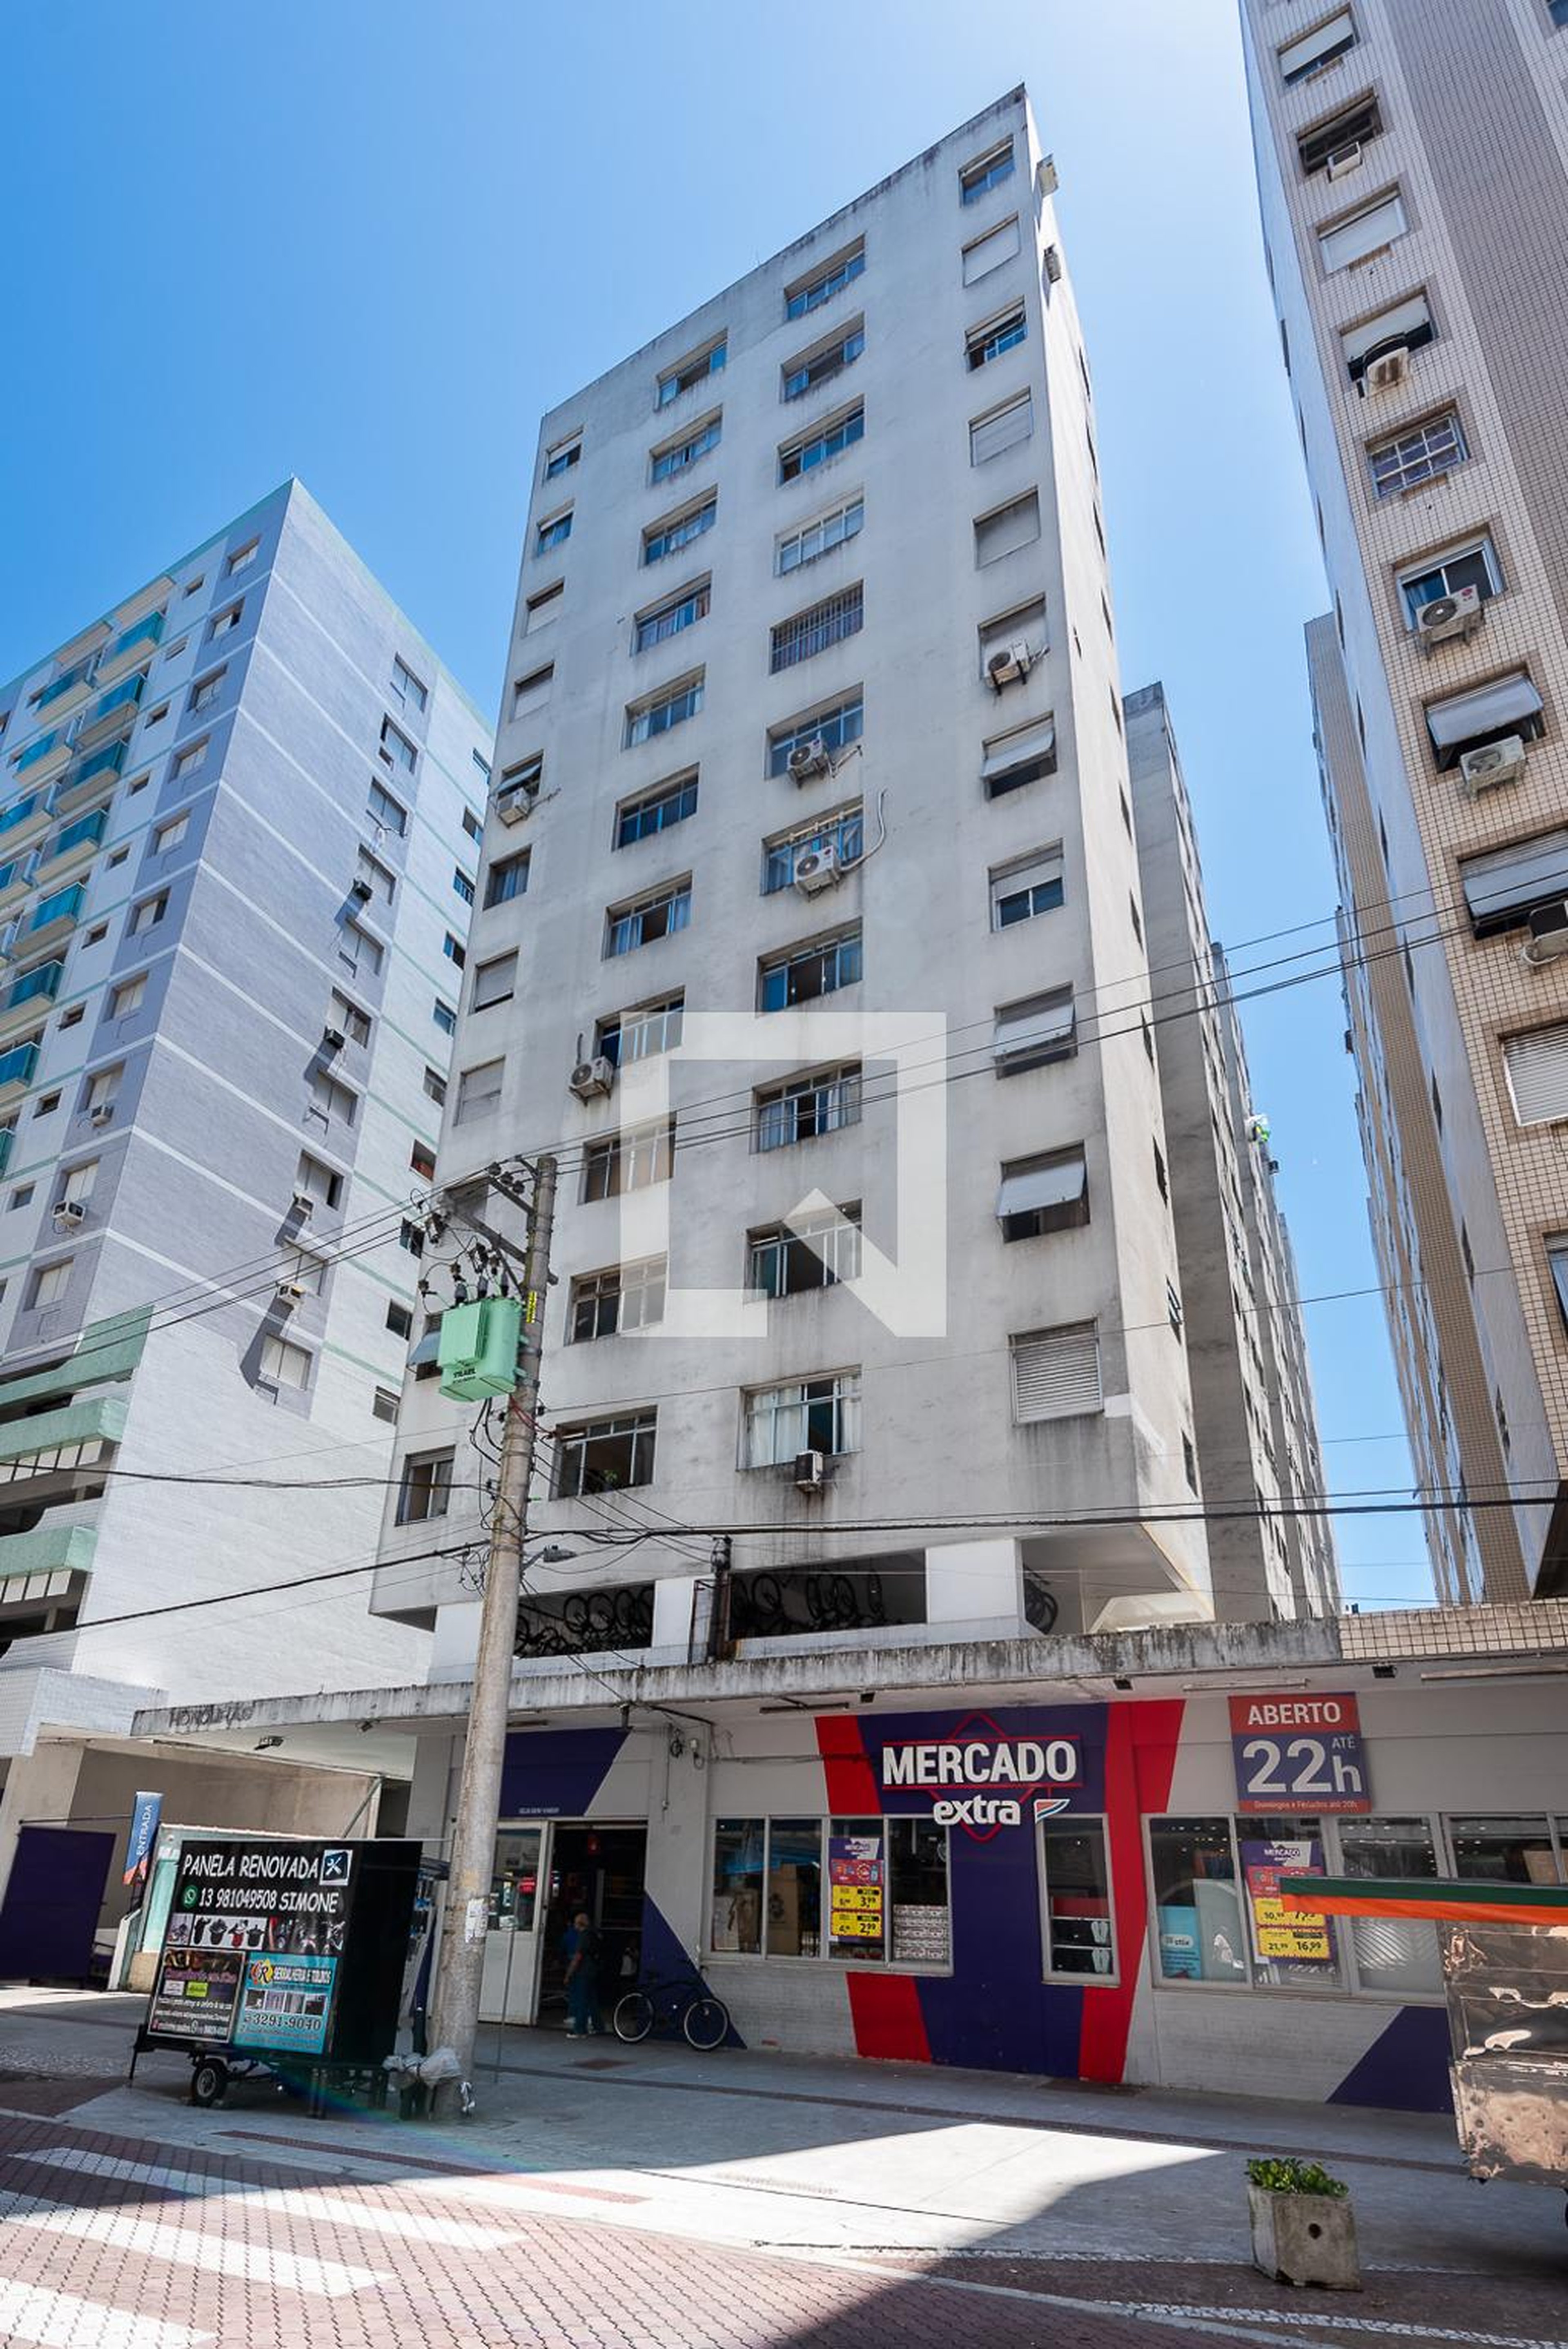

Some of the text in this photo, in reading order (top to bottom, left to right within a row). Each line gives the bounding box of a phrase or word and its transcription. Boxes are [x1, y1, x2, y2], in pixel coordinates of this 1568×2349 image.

[1248, 1702, 1342, 1725] ABERTO
[1332, 1734, 1356, 1749] ATÉ
[882, 1740, 1077, 1785] MERCADO
[1243, 1738, 1363, 1792] 22h
[933, 1795, 1021, 1825] extra
[136, 1805, 153, 1856] ENTRADA
[182, 1854, 319, 1879] PANELA RENOVADA
[199, 1888, 339, 1913] 13 981049508 SIMONE
[254, 2013, 322, 2031] 3291-9040
